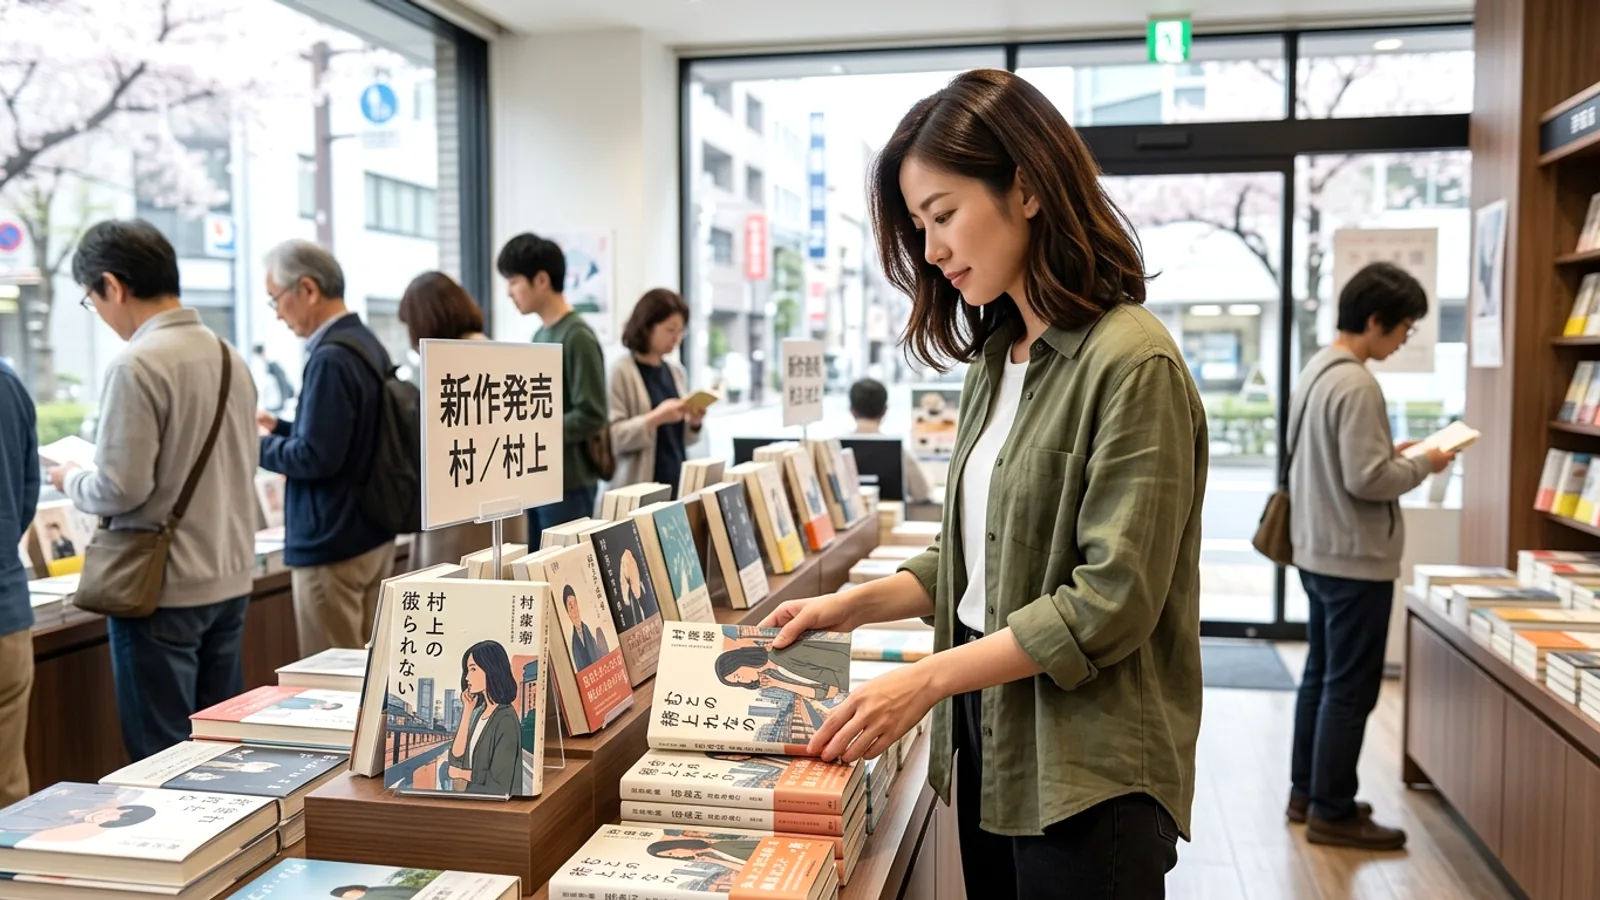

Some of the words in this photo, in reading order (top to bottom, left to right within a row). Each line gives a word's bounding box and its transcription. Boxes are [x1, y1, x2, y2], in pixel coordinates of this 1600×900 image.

[440, 373, 553, 427] 新作発売
[425, 591, 446, 657] 村上の
